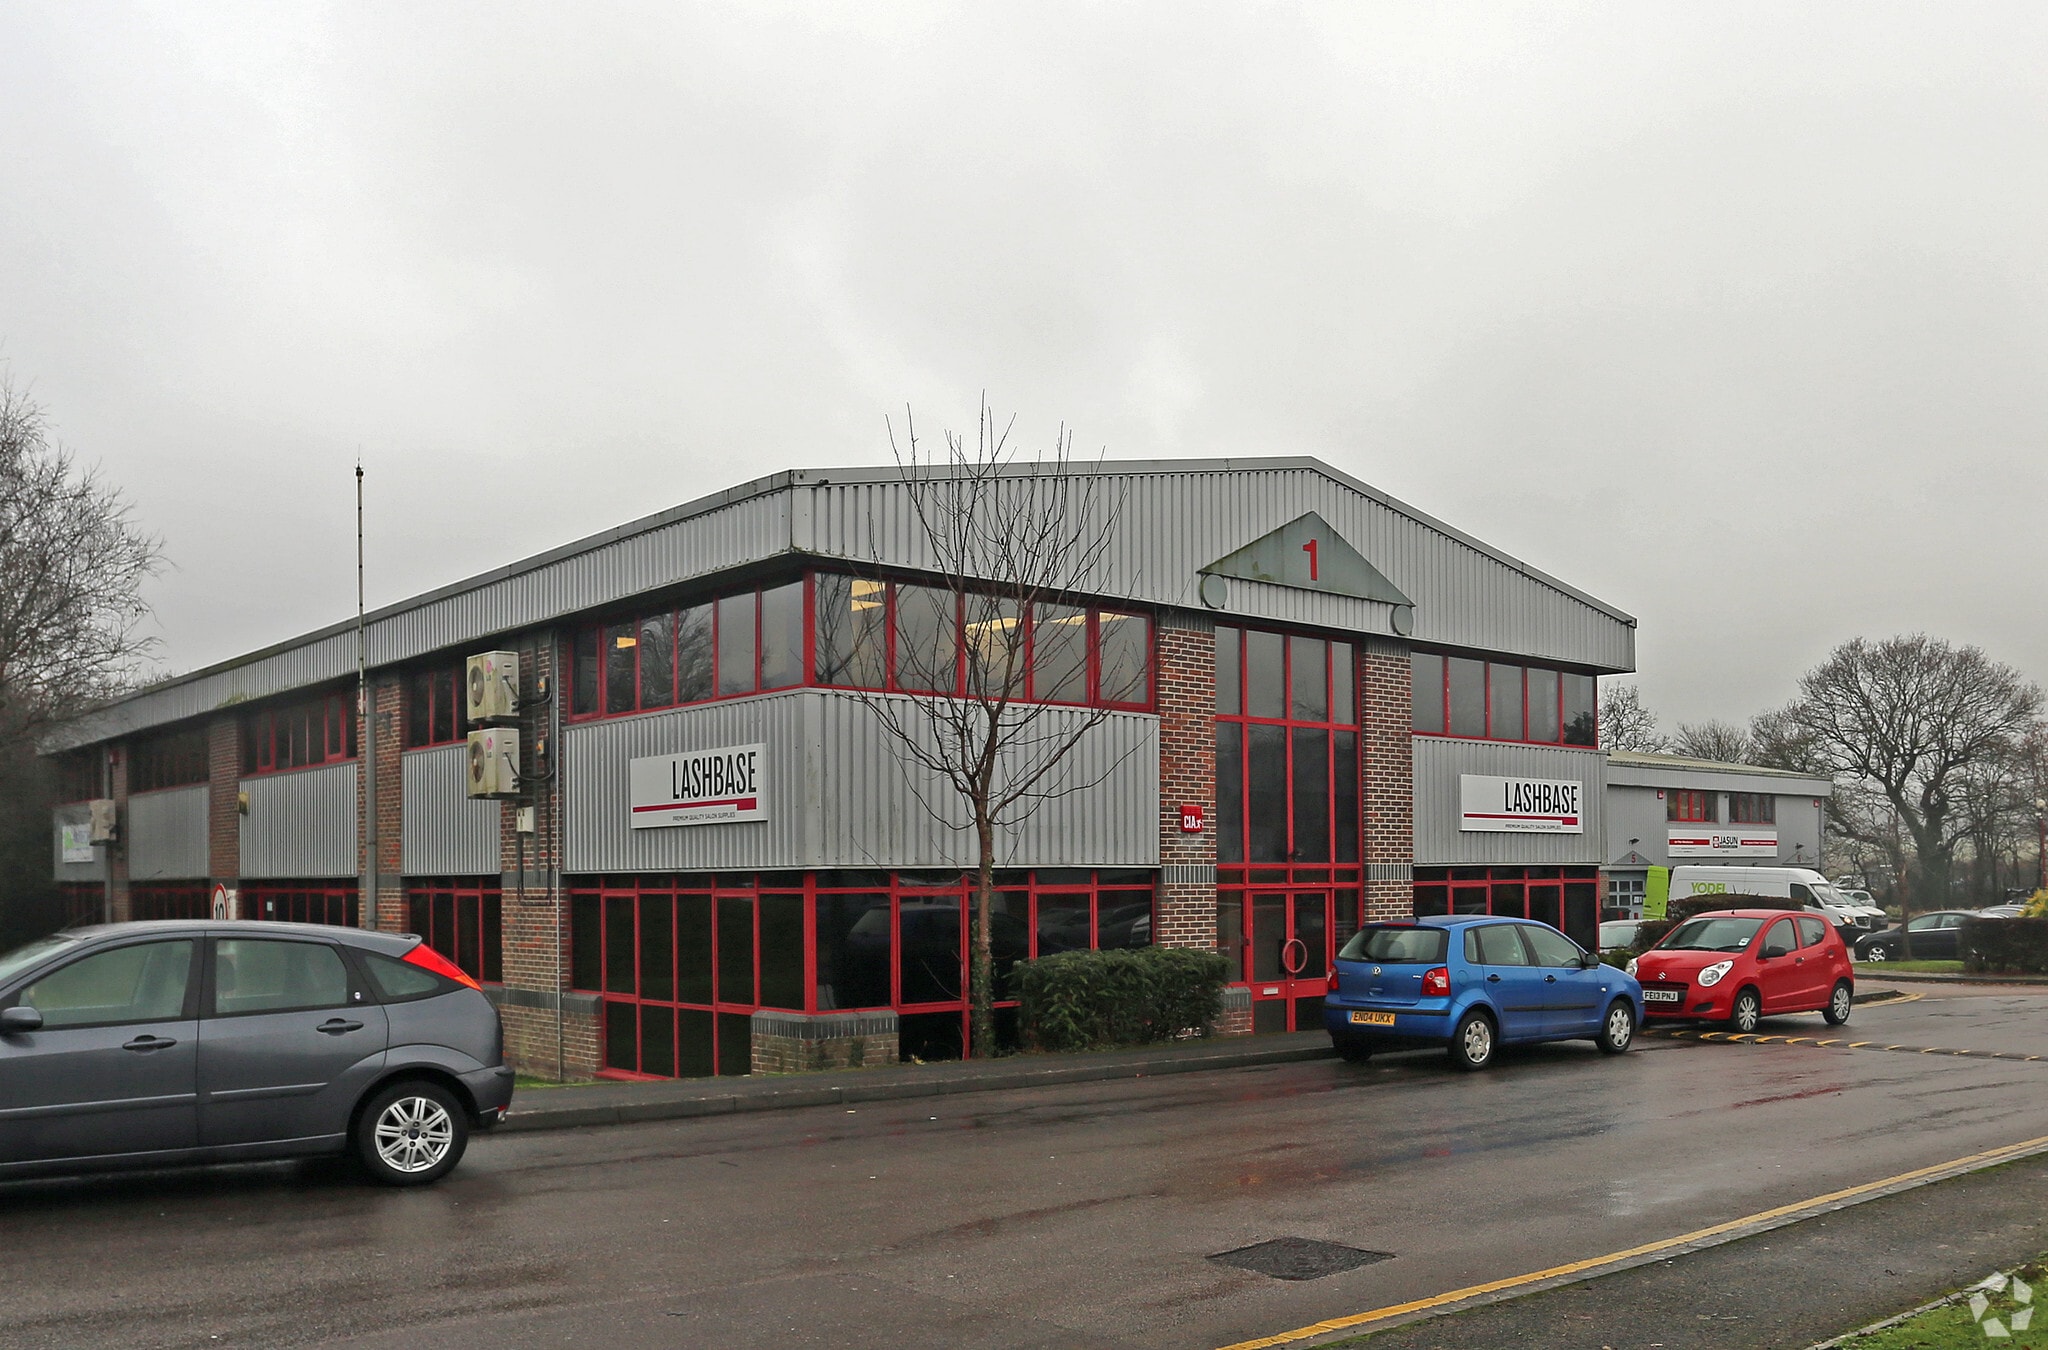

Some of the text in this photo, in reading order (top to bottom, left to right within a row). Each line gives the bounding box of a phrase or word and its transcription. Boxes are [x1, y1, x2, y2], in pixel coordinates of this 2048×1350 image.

[1303, 539, 1317, 581] 1
[673, 752, 756, 799] LASHBASE
[1505, 782, 1578, 814] LASHBASE
[1631, 854, 1636, 863] 5
[1354, 1012, 1391, 1023] EN04 UKX
